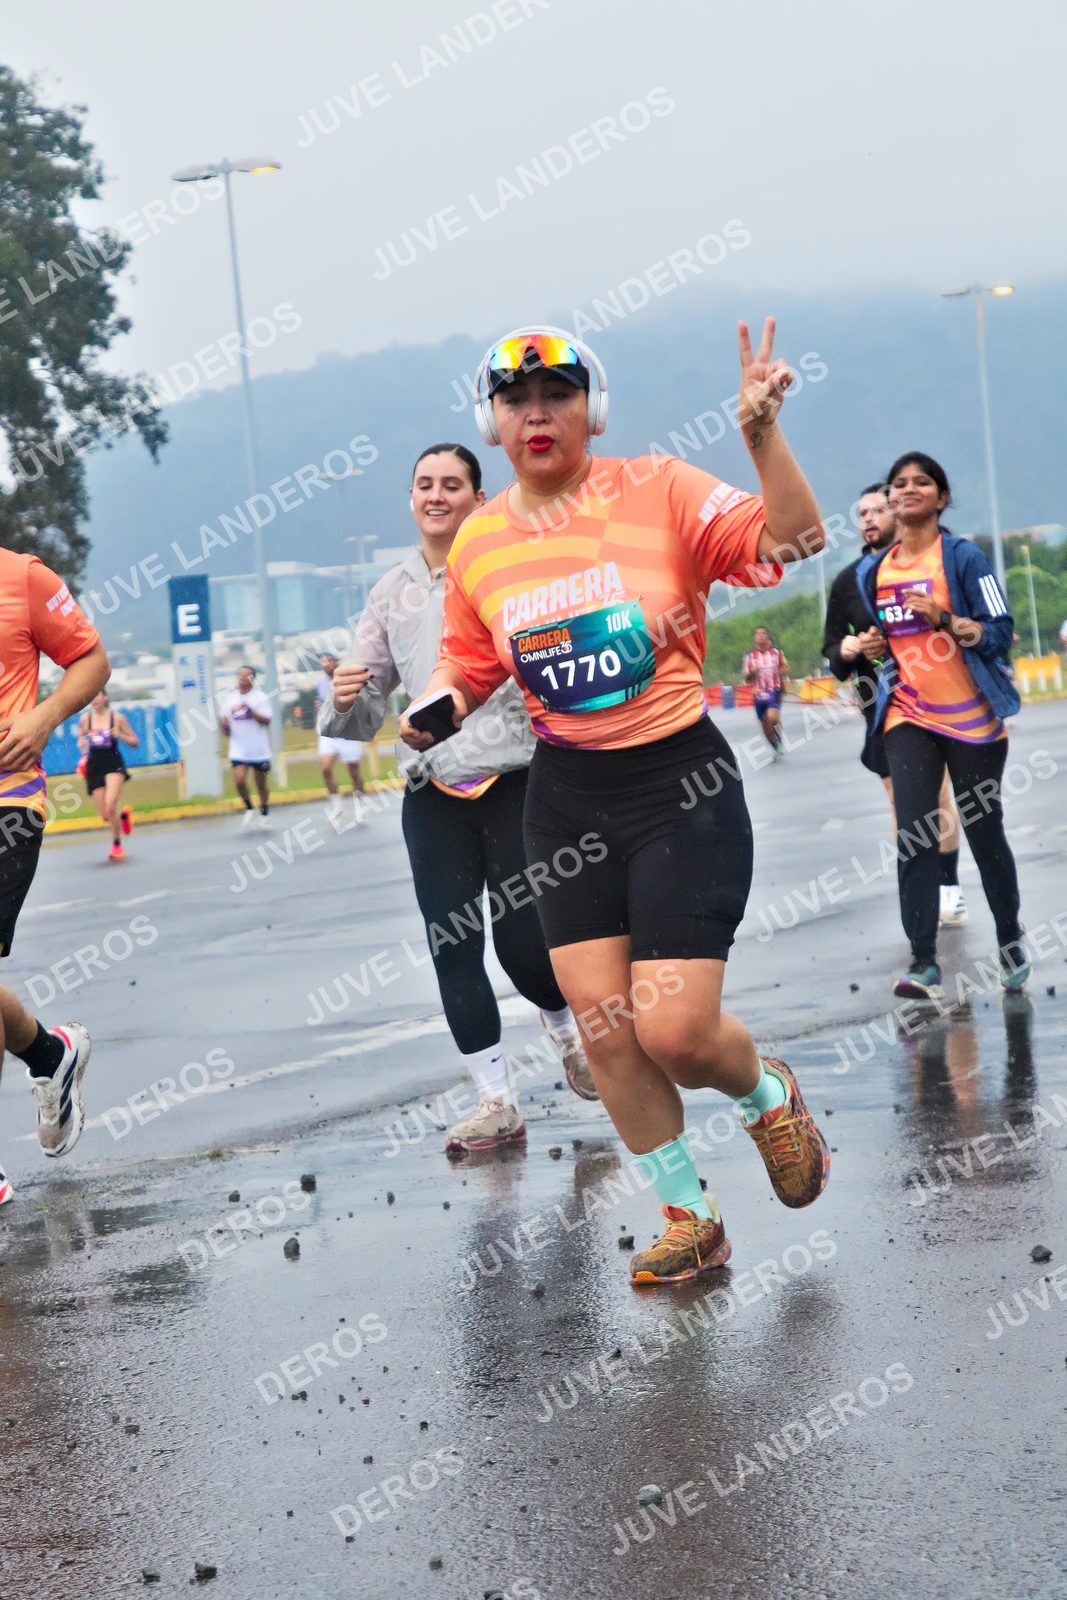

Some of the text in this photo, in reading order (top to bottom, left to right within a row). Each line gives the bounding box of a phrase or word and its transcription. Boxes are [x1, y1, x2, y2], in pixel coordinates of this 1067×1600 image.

[503, 561, 625, 632] CARRERA
[177, 603, 202, 636] E
[605, 609, 632, 634] 10K
[518, 628, 571, 653] CARRERA
[541, 649, 621, 690] 1770
